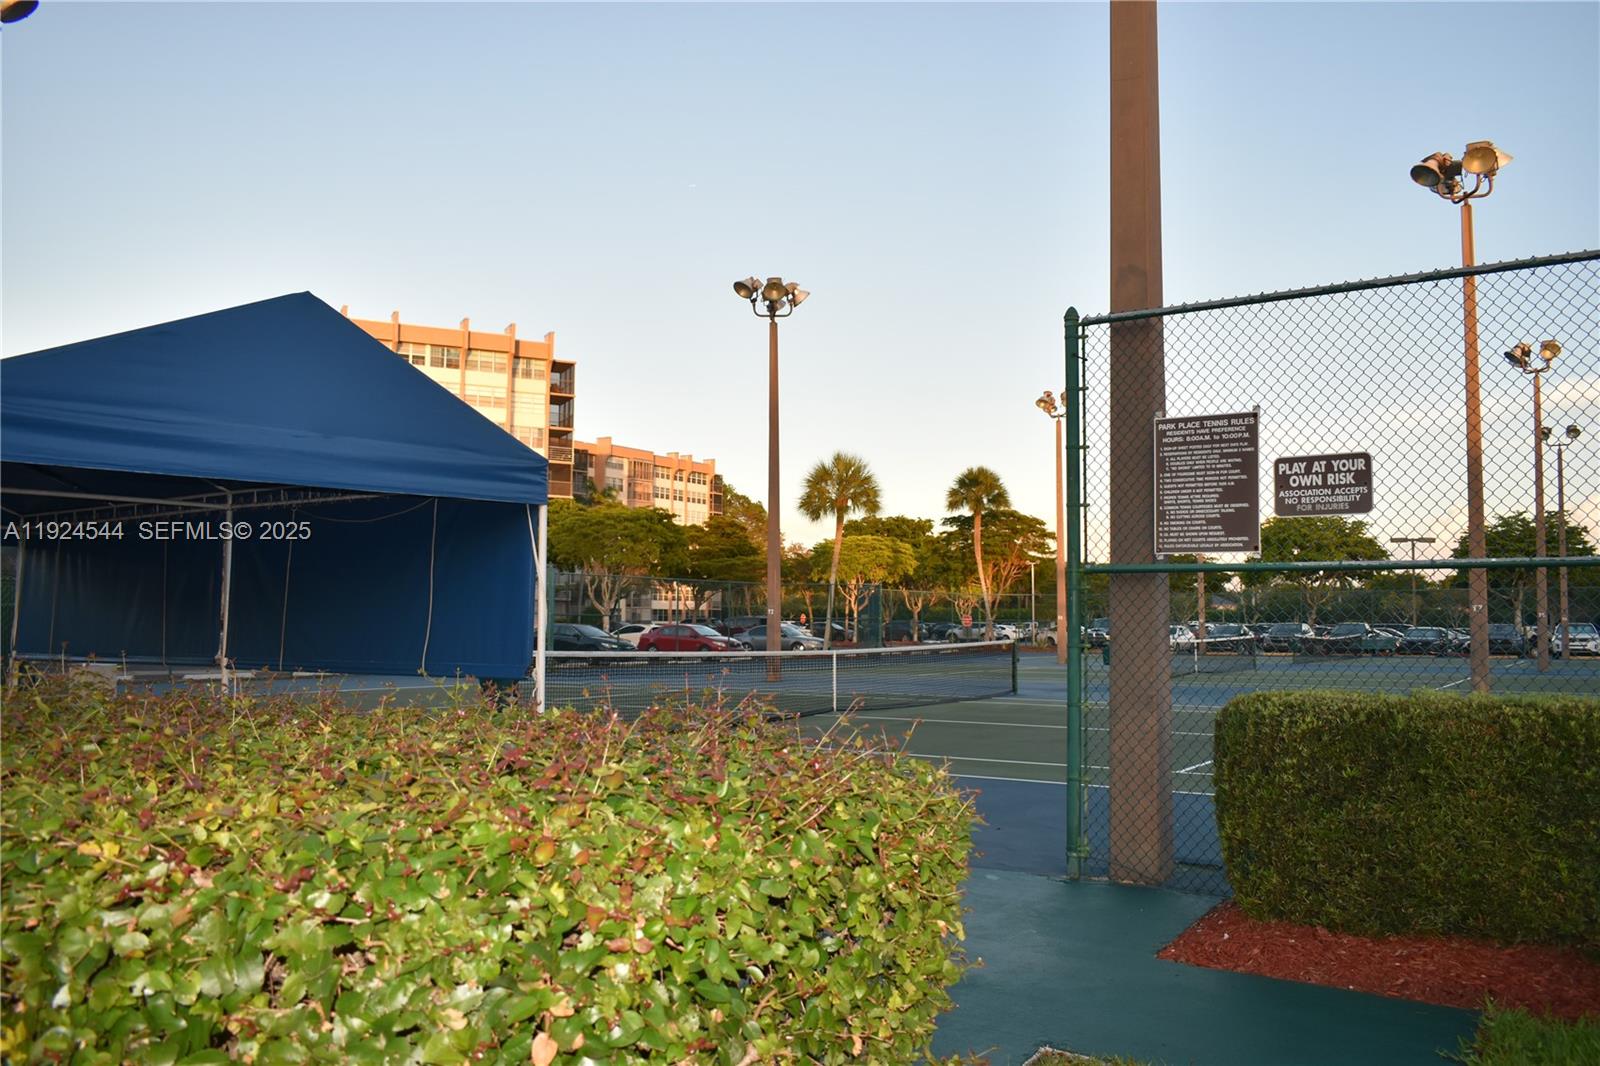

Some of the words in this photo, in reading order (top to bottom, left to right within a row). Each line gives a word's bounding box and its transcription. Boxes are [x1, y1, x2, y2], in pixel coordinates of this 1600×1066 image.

[1203, 419, 1228, 427] TENNIS
[1231, 417, 1255, 425] RULES
[1278, 462, 1307, 475] PLAY
[1312, 461, 1327, 473] AT
[1331, 458, 1366, 471] YOUR
[1289, 474, 1322, 487] OWN
[1327, 472, 1356, 485] RISK
[1279, 488, 1331, 498] ASSOCIATION
[1301, 494, 1361, 504] RESPONSIBILITY
